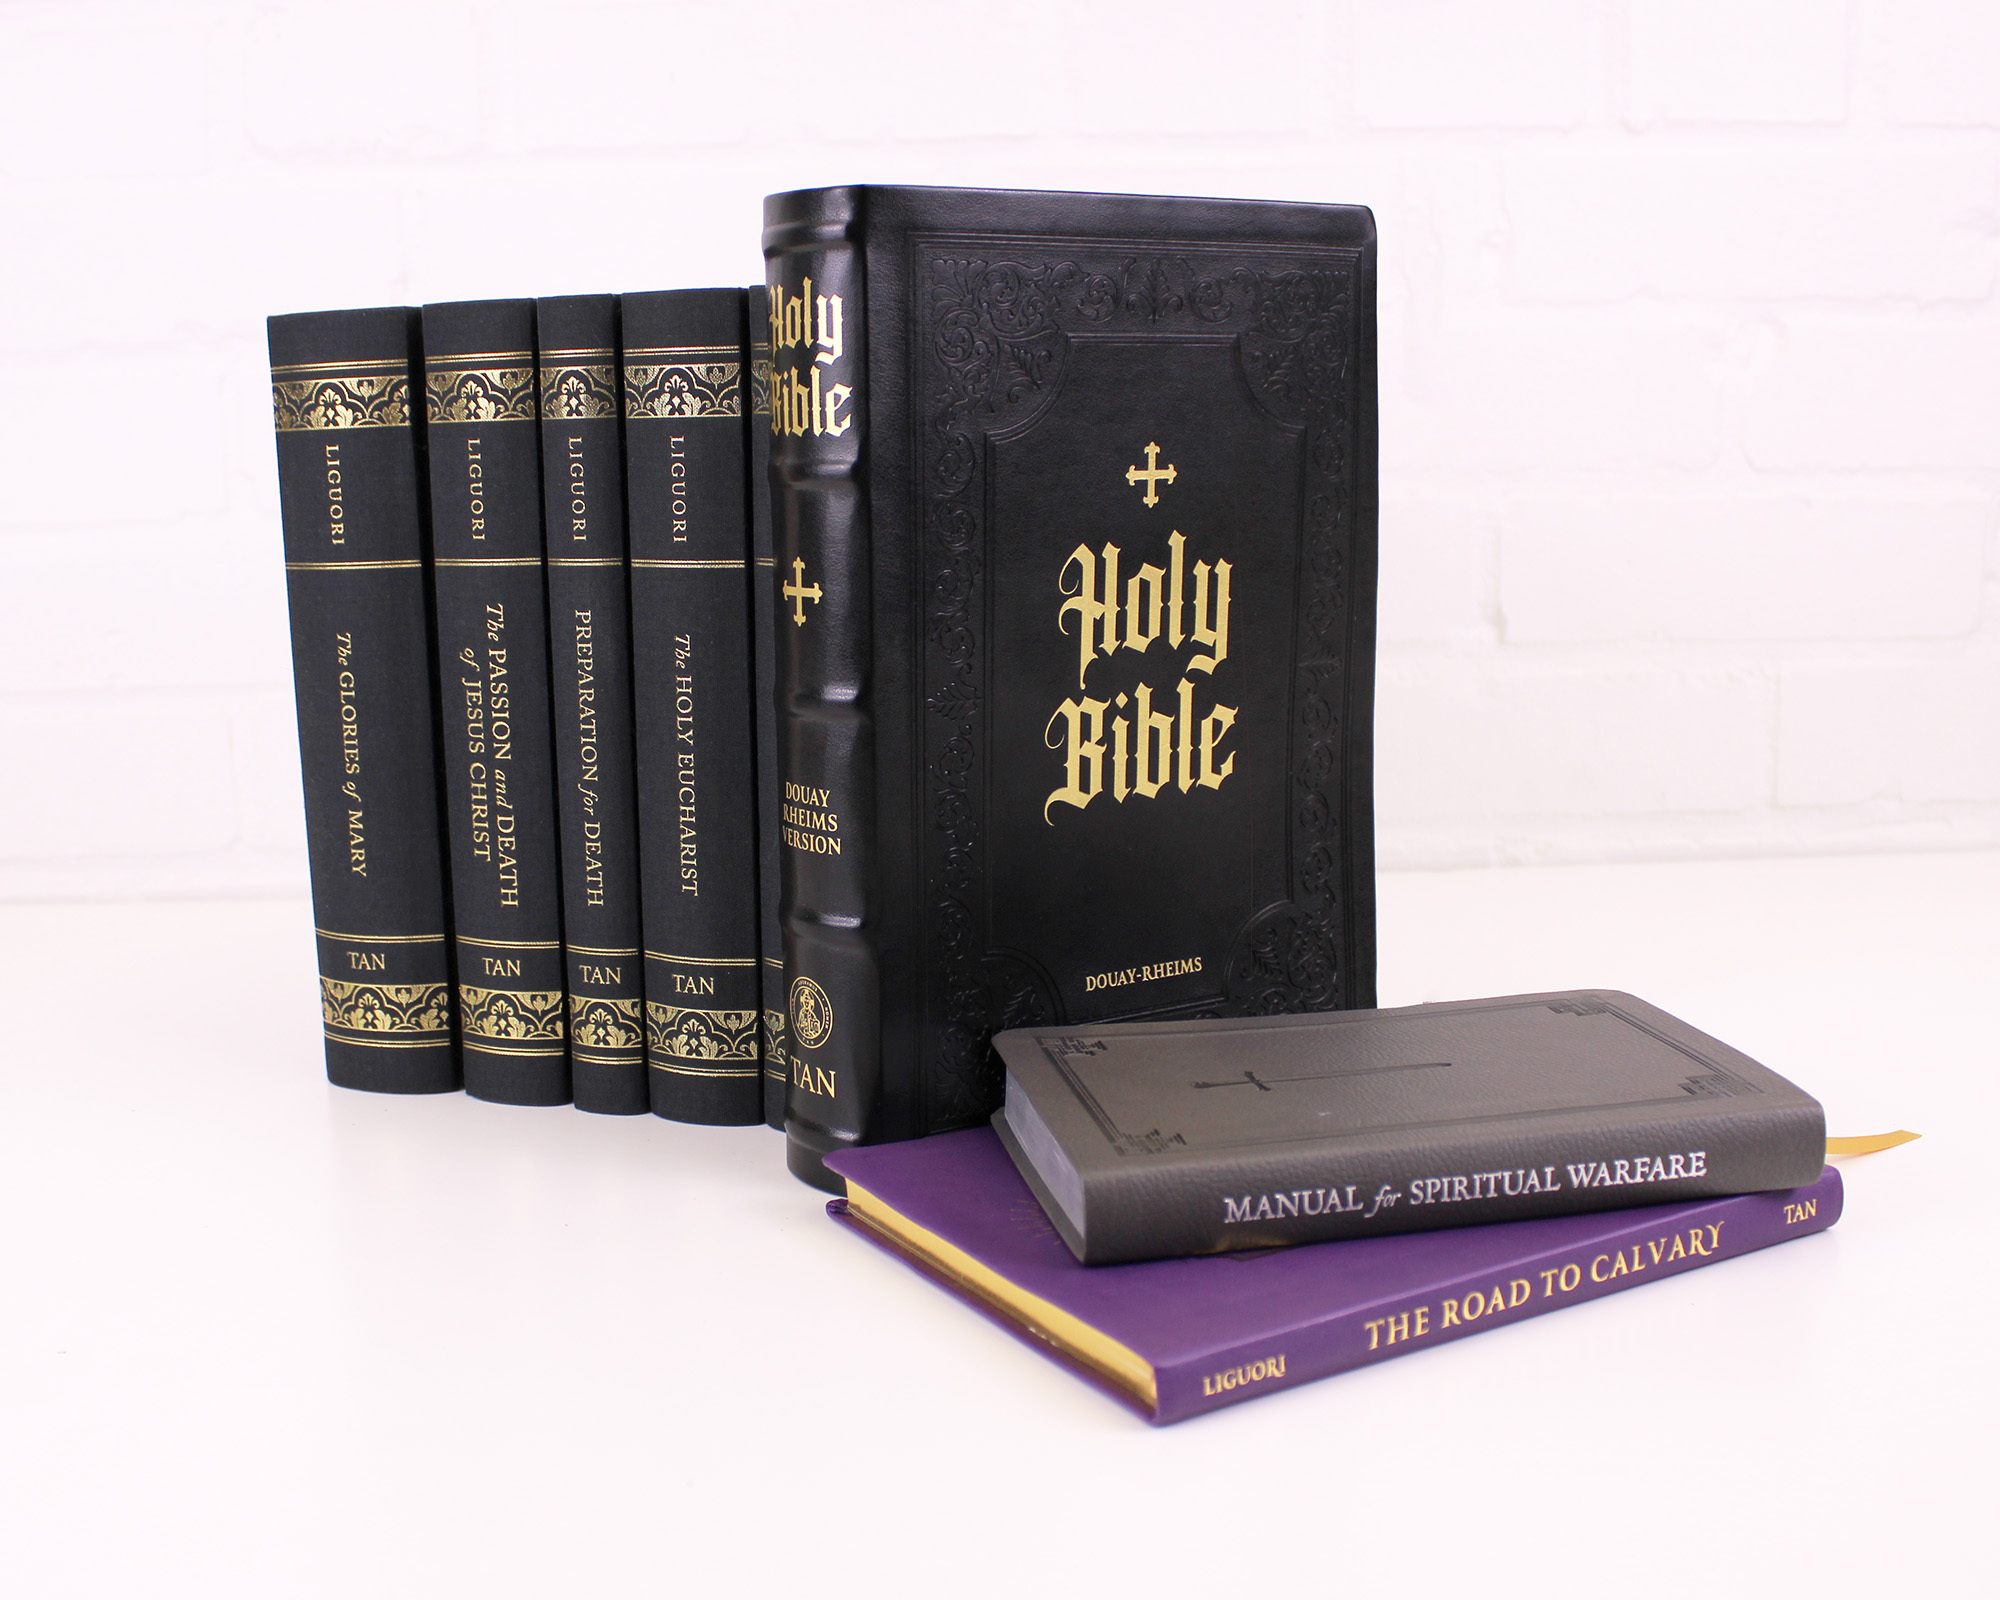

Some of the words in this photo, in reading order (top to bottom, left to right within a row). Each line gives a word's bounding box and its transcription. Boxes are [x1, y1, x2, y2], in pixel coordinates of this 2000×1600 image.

[769, 276, 844, 367] Holy
[770, 365, 852, 437] Bible
[326, 445, 344, 544] LIGUORI
[468, 439, 485, 539] LIGUORI
[569, 437, 586, 540] LIGUORI
[670, 436, 686, 542] LIGUORI
[487, 603, 504, 641] The
[1059, 530, 1233, 690] Holy
[337, 633, 351, 665] The
[460, 648, 480, 671] of
[675, 634, 690, 669] The
[340, 672, 360, 774] GLORIES
[462, 678, 484, 753] JESUS
[489, 649, 511, 759] PASSION
[575, 610, 598, 781] PREPARATION
[676, 676, 693, 746] HOLY
[1044, 677, 1238, 826] Bible
[342, 782, 361, 802] of
[470, 763, 490, 861] CHRIST
[495, 769, 512, 809] and
[578, 784, 598, 816] for
[784, 804, 837, 831] RHEIMS
[786, 782, 830, 807] DOUAY
[349, 810, 366, 876] MARY
[678, 753, 698, 896] EUCHARIST
[782, 825, 841, 855] VERSION
[497, 815, 518, 906] DEATH
[585, 822, 603, 906] DEATH
[347, 952, 385, 970] TAN
[482, 958, 520, 976] TAN
[579, 965, 620, 984] TAN
[672, 974, 713, 994] TAN
[1086, 957, 1202, 991] DOUAY-RHEIMS
[791, 1056, 836, 1098] TAN
[1223, 1185, 1363, 1223] MANUAL
[1364, 1184, 1402, 1218] for
[1410, 1166, 1561, 1204] SPIRITUAL
[1567, 1152, 1707, 1188] WARFARE
[1784, 1199, 1816, 1224] TAN
[1365, 1307, 1429, 1350] THE
[1442, 1279, 1530, 1328] ROAD
[1541, 1264, 1580, 1297] TO
[1591, 1221, 1724, 1282] CALVARY
[1204, 1355, 1285, 1396] LIGUORI
